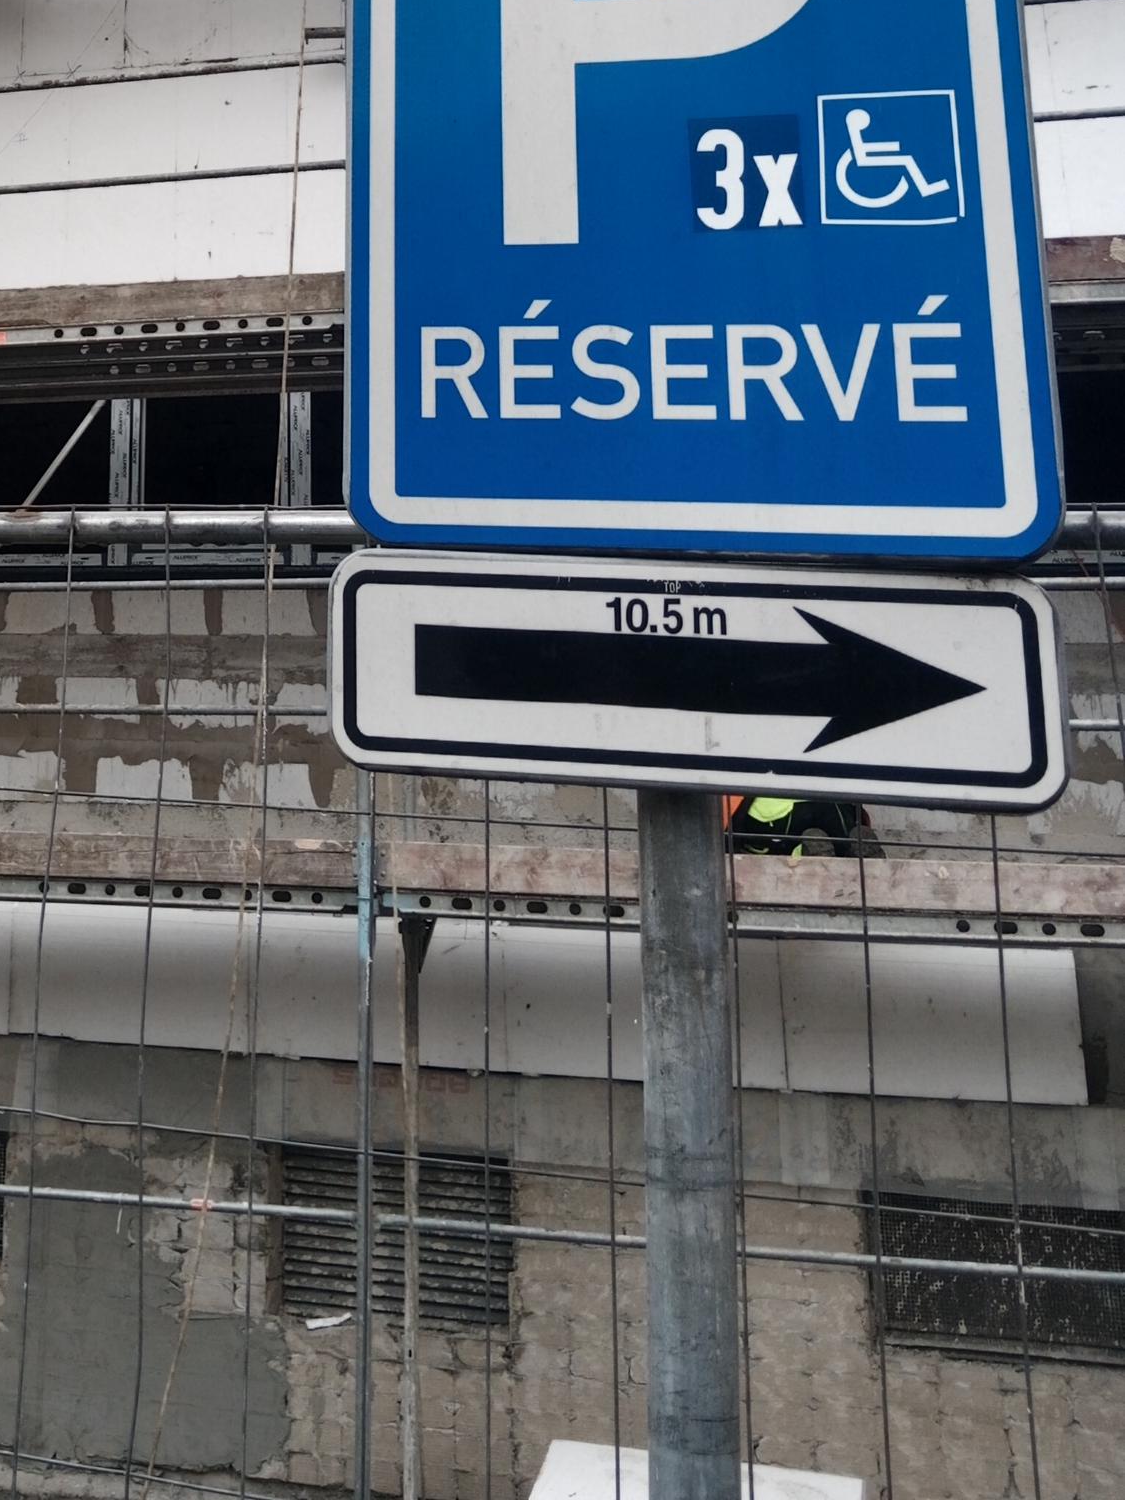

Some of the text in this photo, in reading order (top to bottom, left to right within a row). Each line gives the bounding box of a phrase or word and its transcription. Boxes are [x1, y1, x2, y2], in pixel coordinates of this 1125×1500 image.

[694, 127, 806, 231] 3x
[420, 293, 968, 423] RÉSERVÉ
[605, 597, 727, 636] 10.5 m
[663, 581, 681, 593] TOP
